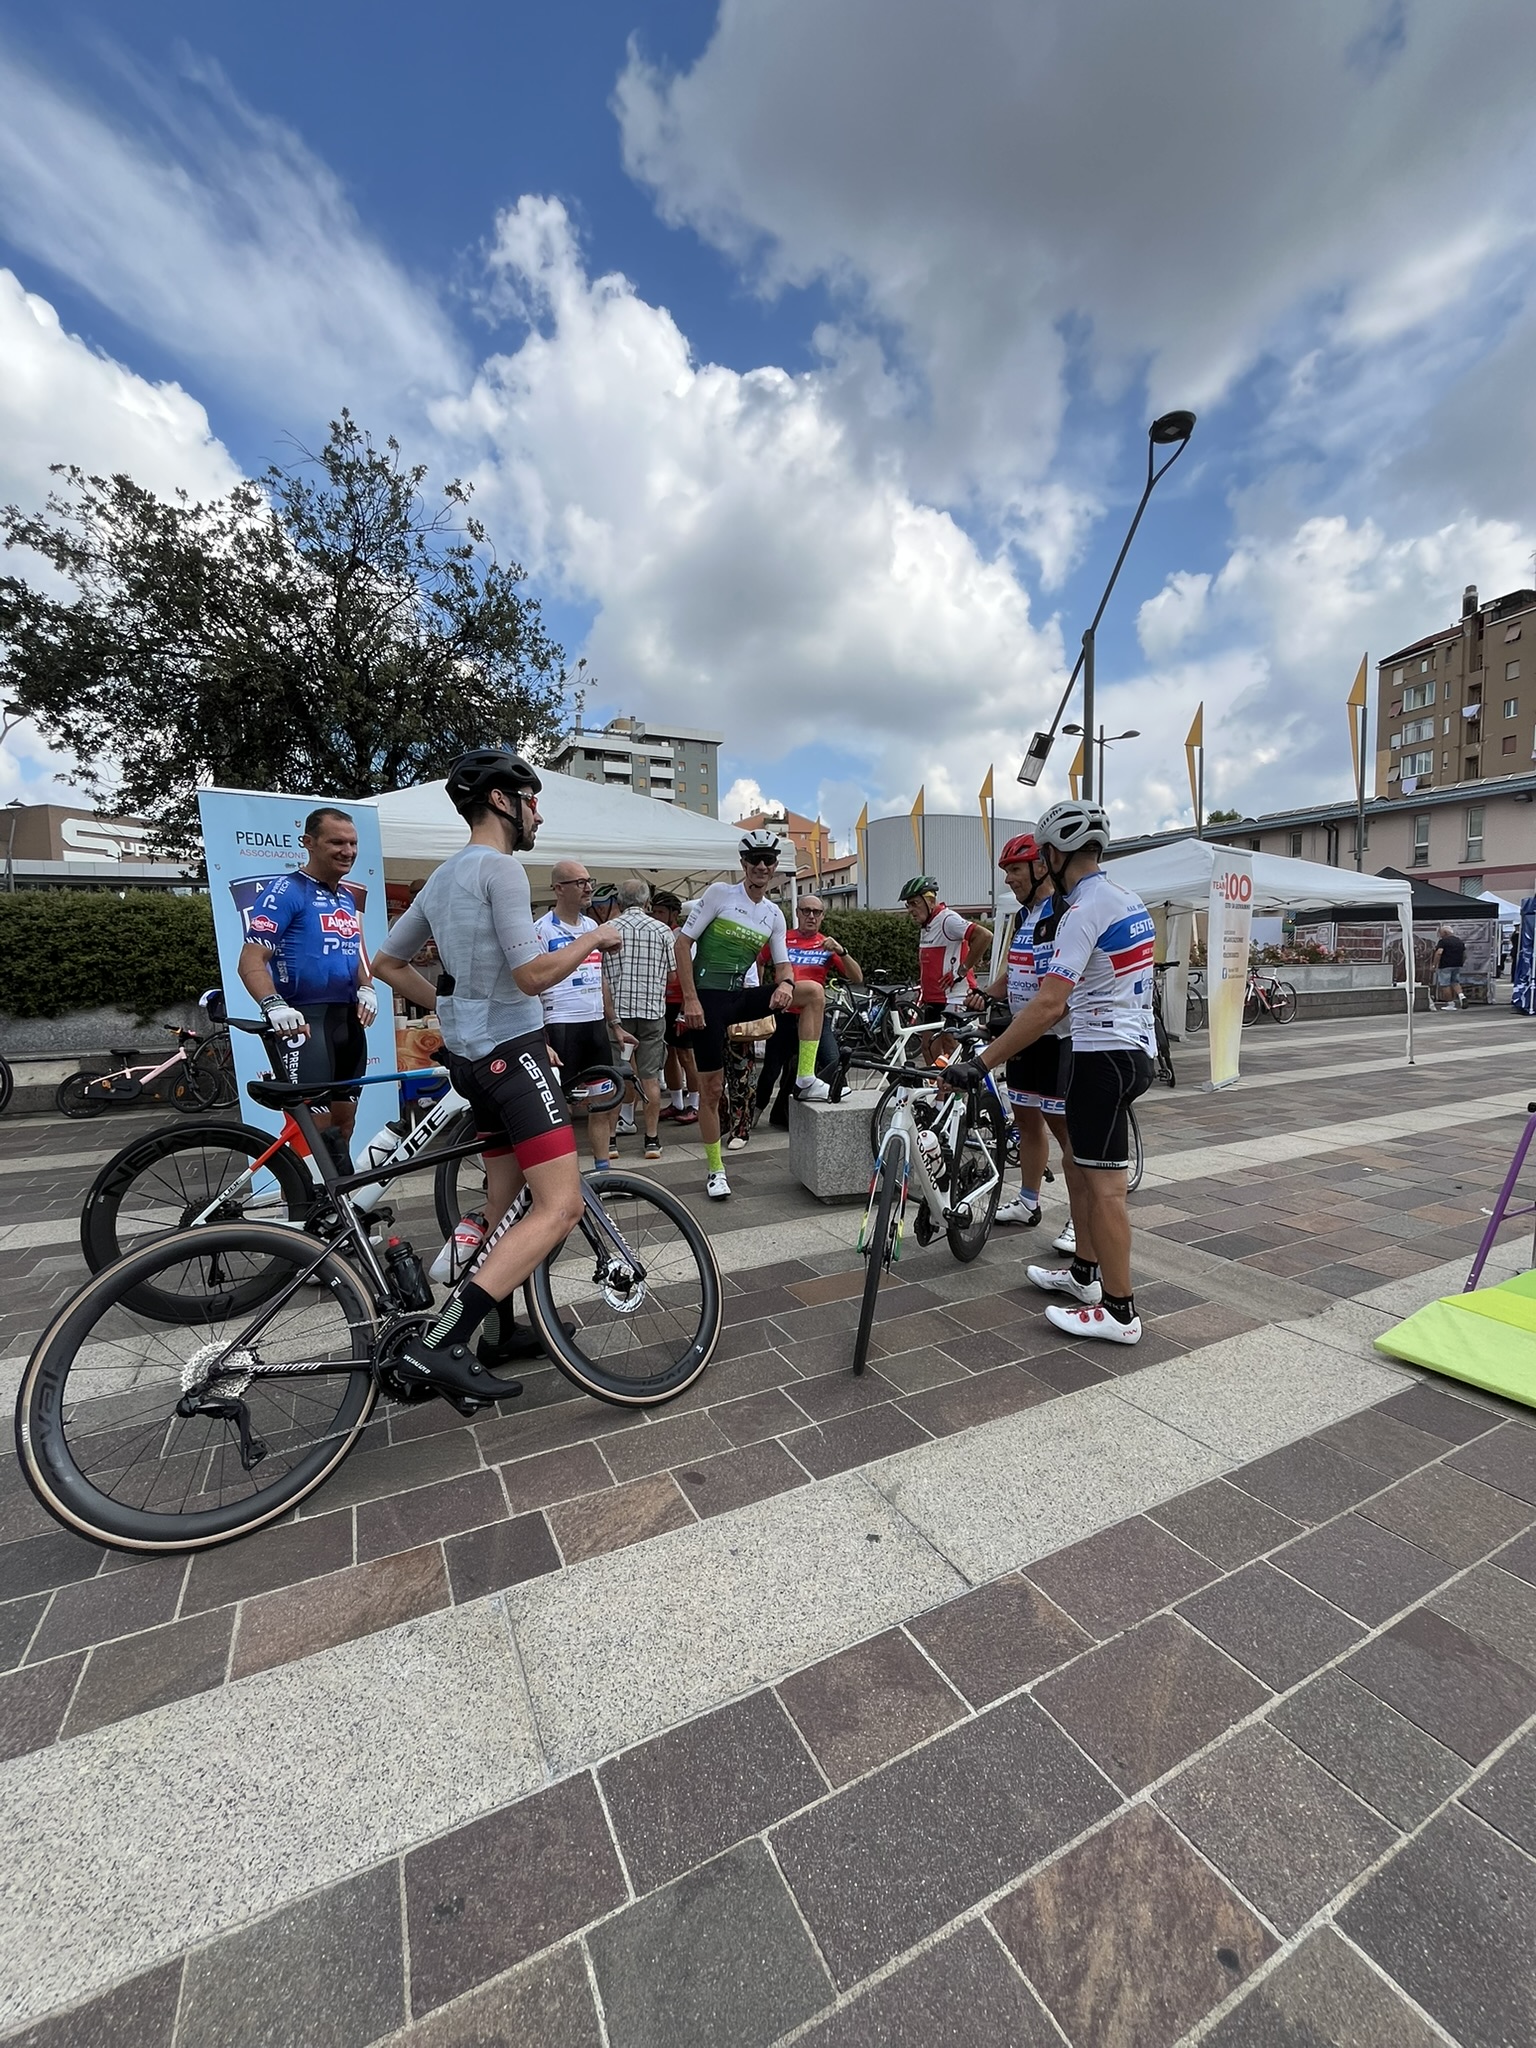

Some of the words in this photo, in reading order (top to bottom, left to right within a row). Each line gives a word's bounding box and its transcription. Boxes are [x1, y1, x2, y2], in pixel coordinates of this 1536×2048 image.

[235, 830, 292, 848] PEDALE
[239, 848, 307, 860] ASSOCIAZIONE
[788, 954, 828, 966] STESE
